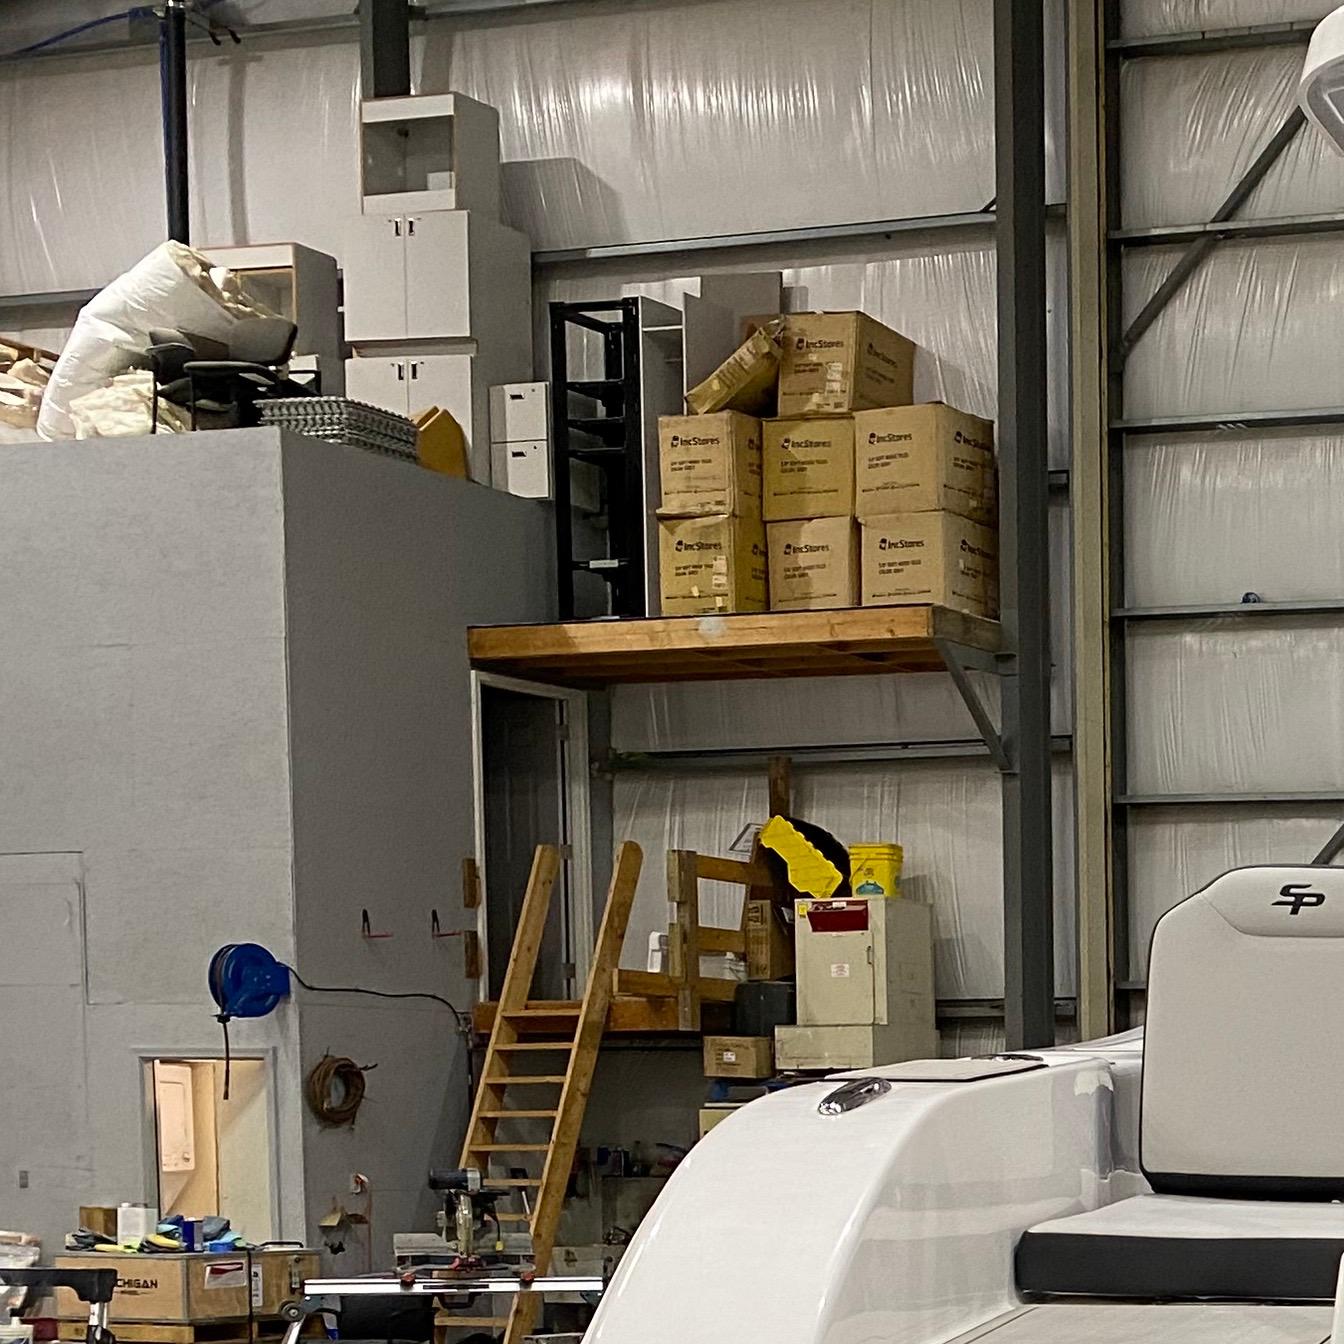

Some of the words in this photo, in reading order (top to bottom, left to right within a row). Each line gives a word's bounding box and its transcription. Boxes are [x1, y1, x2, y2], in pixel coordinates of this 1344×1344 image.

[805, 339, 844, 349] IncStores
[681, 436, 720, 446] IncStores
[876, 433, 912, 443] IncStores
[791, 440, 832, 448] IncStores
[684, 542, 722, 551] IncStores
[793, 544, 830, 554] IncStores
[888, 540, 924, 549] IncStores
[116, 1279, 158, 1289] CHIGAN
